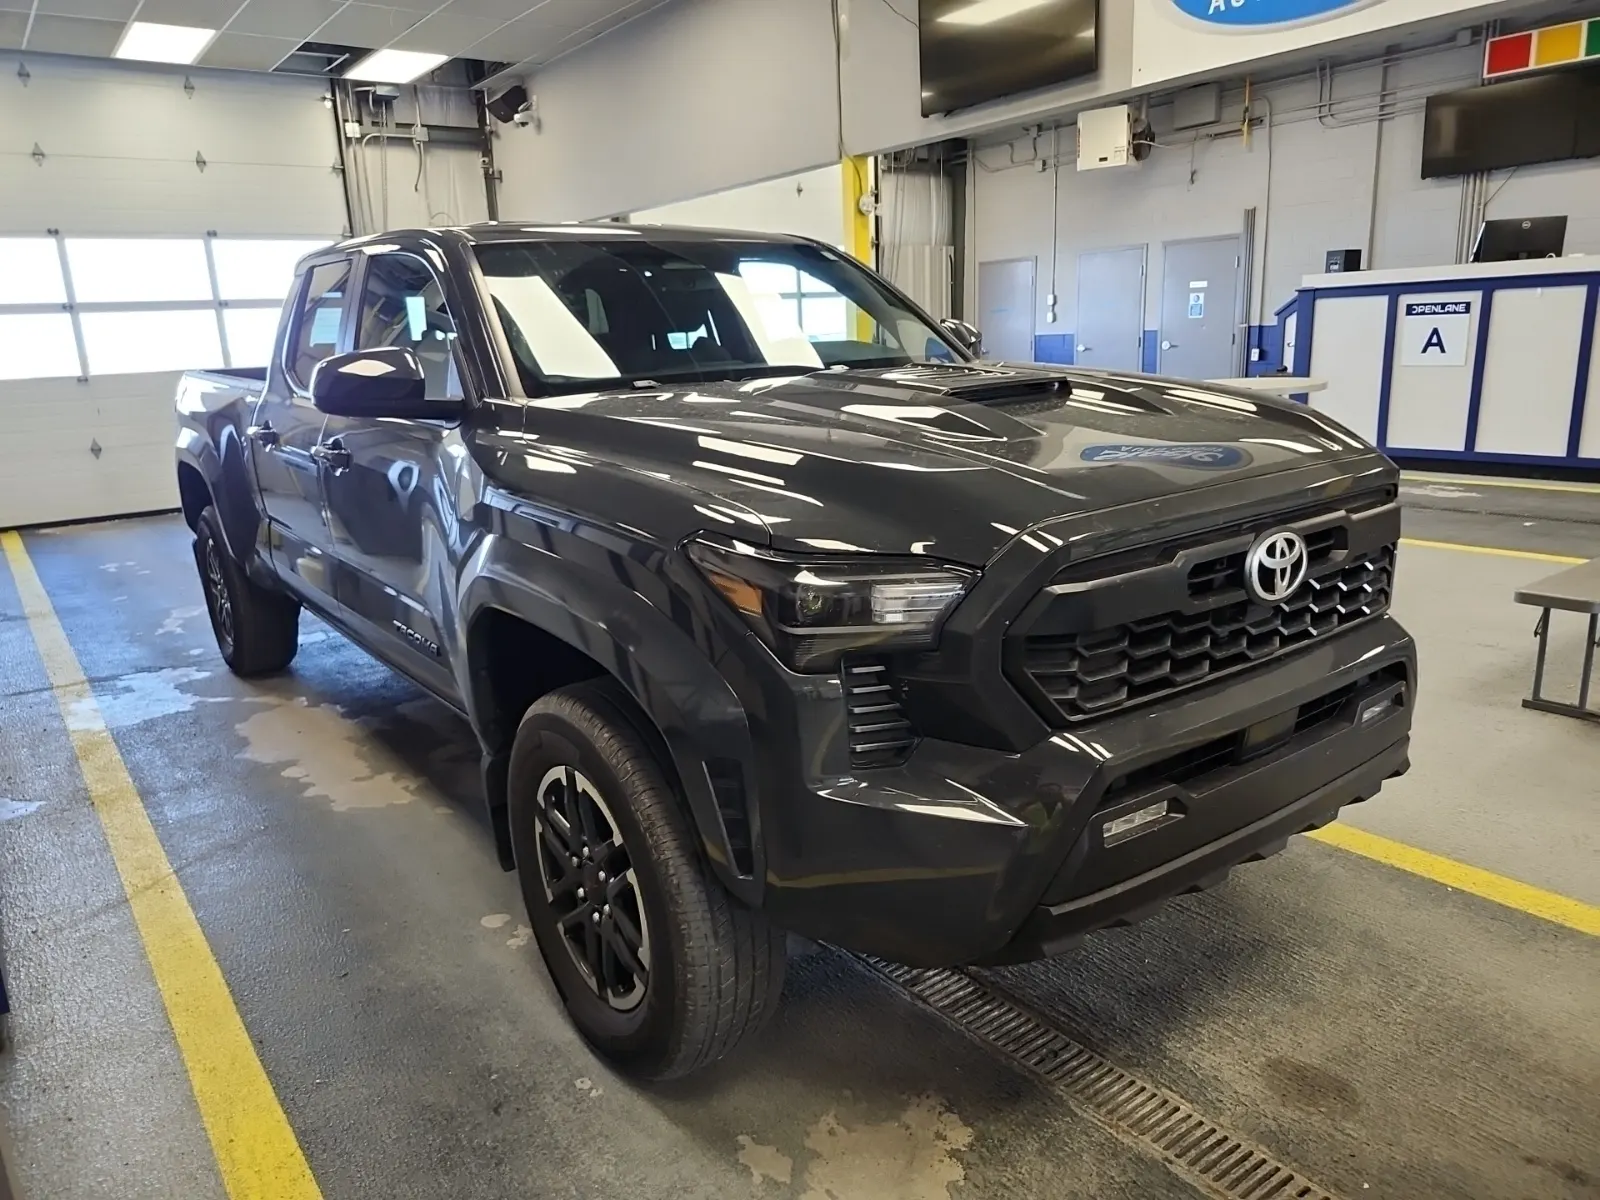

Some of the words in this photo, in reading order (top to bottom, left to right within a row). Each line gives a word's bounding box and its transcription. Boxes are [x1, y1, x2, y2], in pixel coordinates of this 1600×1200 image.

[1411, 303, 1467, 314] OPENLANE
[1420, 327, 1447, 354] A
[393, 619, 440, 656] TACOMA
